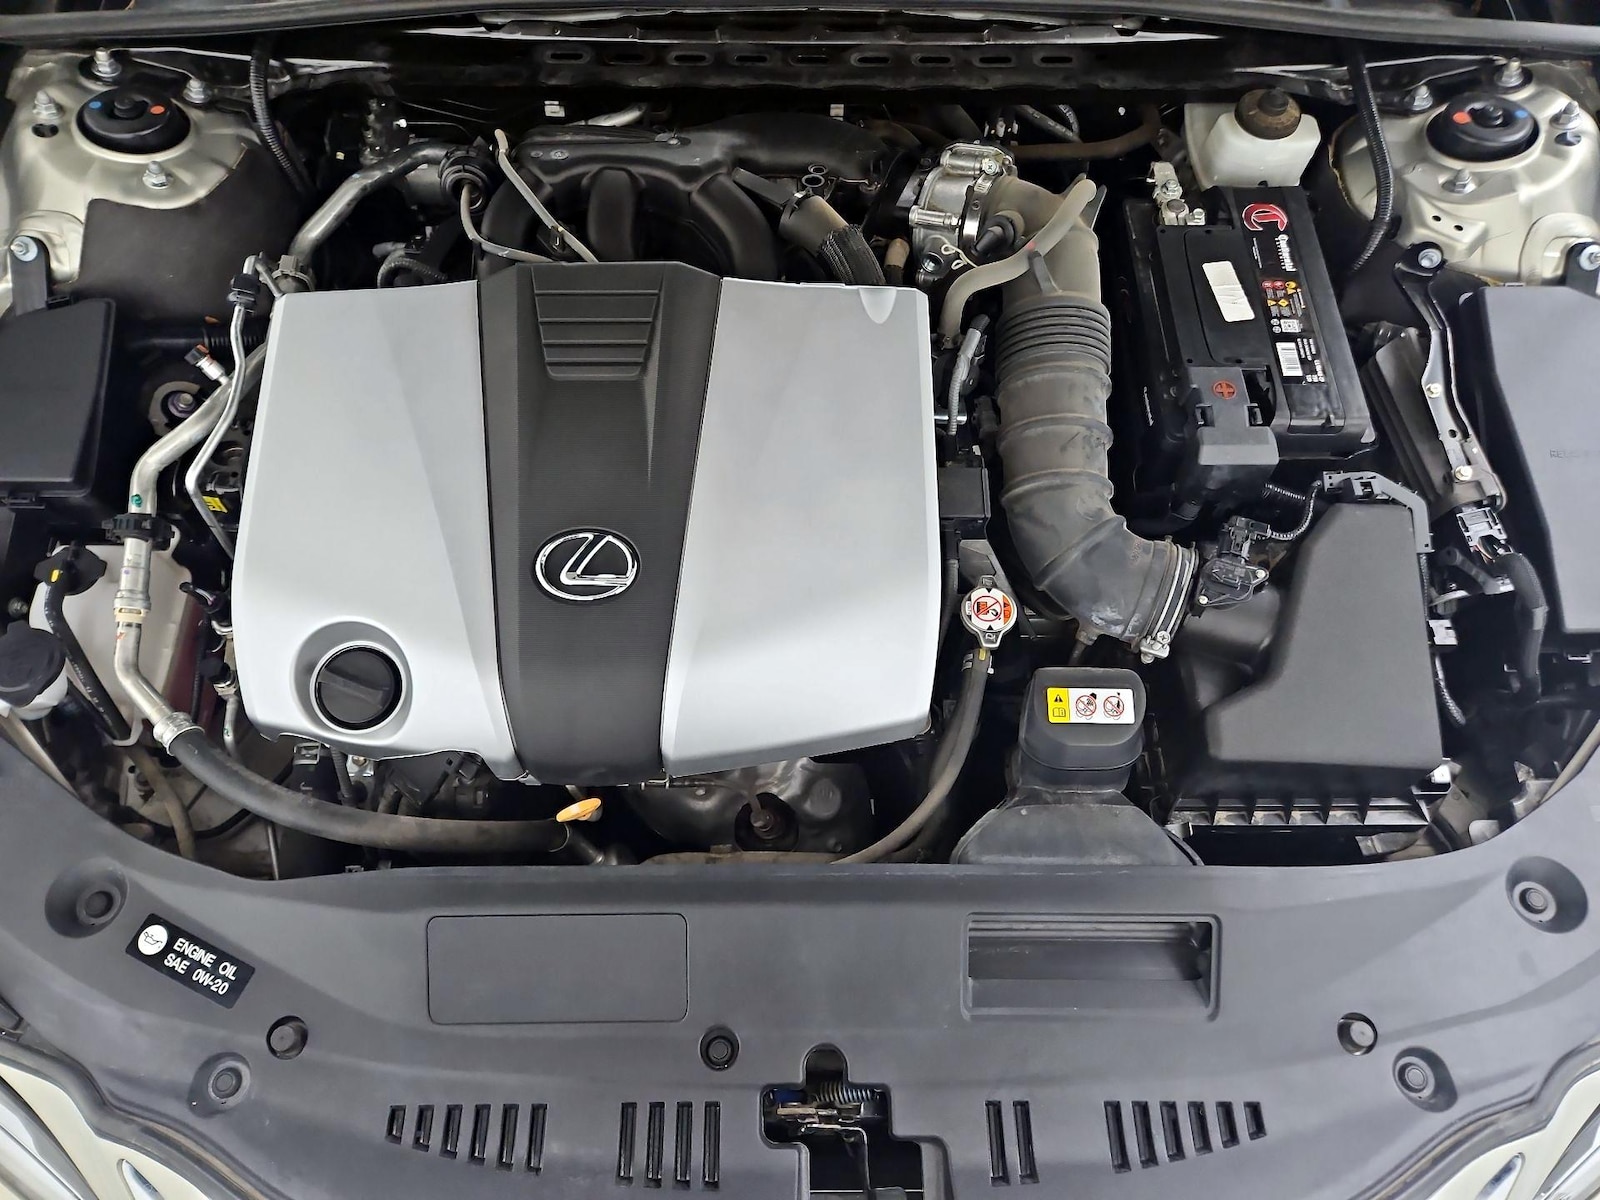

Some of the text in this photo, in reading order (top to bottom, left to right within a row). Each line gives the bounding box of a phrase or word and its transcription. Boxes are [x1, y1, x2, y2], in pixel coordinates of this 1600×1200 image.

[163, 953, 229, 995] SAE 0W-20
[173, 937, 238, 981] ENGINE OIL
